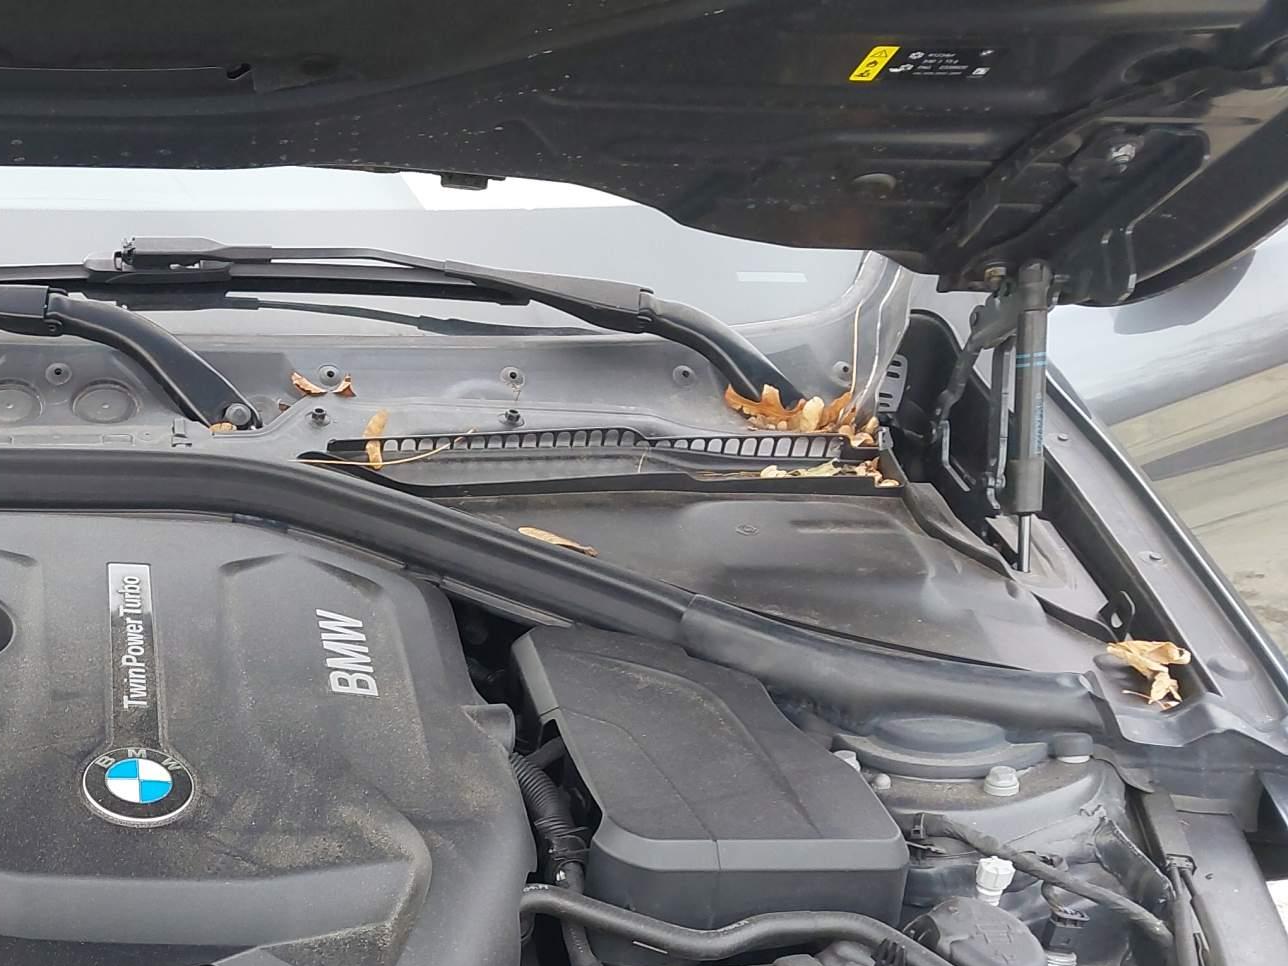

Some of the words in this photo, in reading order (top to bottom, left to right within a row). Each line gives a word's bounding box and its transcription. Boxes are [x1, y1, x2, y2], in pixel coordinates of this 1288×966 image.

[118, 575, 142, 618] Turbo
[121, 617, 148, 711] TwinPower
[315, 608, 379, 697] BMW
[95, 748, 183, 771] BMW
